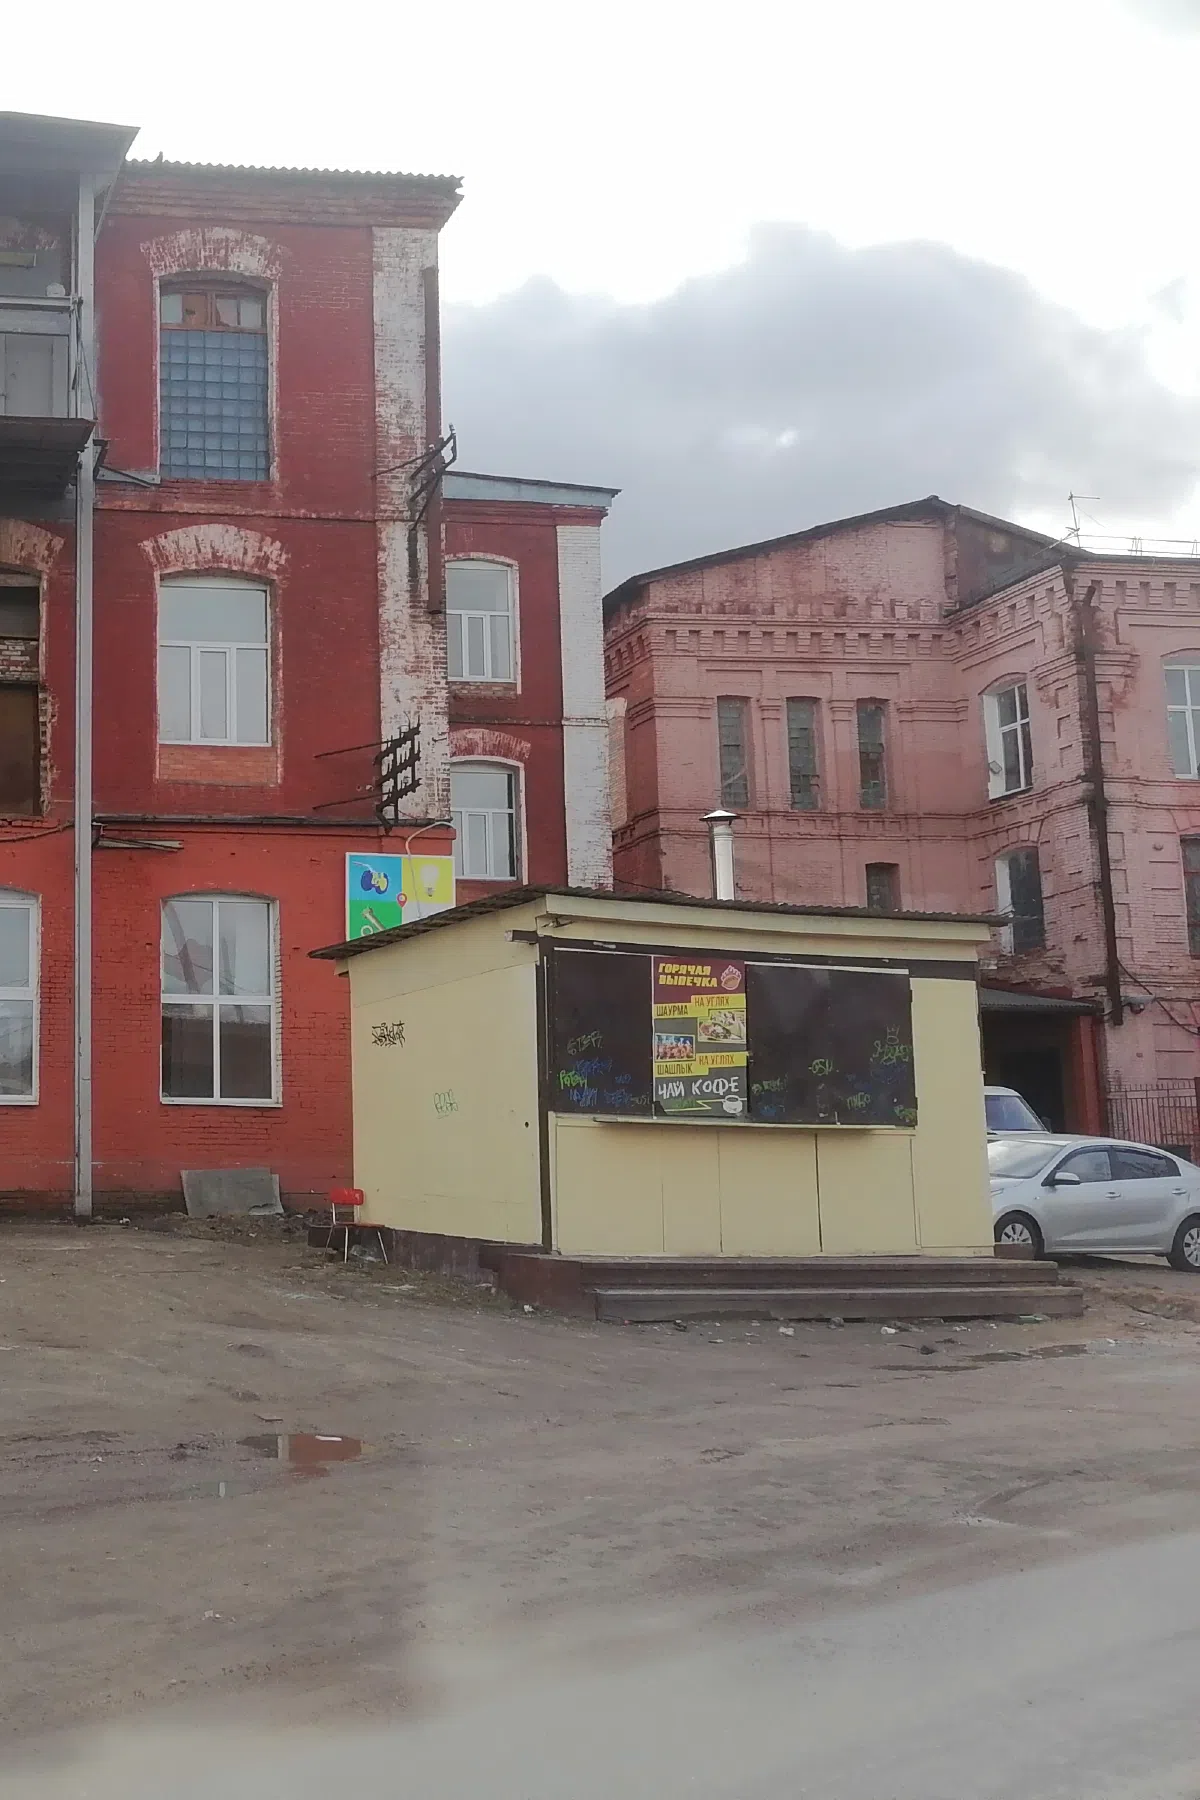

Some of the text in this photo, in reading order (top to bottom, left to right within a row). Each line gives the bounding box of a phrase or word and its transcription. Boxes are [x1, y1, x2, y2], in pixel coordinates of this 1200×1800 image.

[658, 963, 711, 976] ГОРЯЧАЯ
[658, 975, 718, 987] ВЫПЕЧКА
[694, 996, 730, 1007] НА УГЛЯХ
[656, 1004, 689, 1017] ШАУРМА
[699, 1054, 735, 1066] НА УГЛЯХ
[657, 1063, 693, 1075] ШАШЛЫК
[658, 1080, 685, 1099] ЧАЙ
[692, 1076, 740, 1096] КОФЕ
